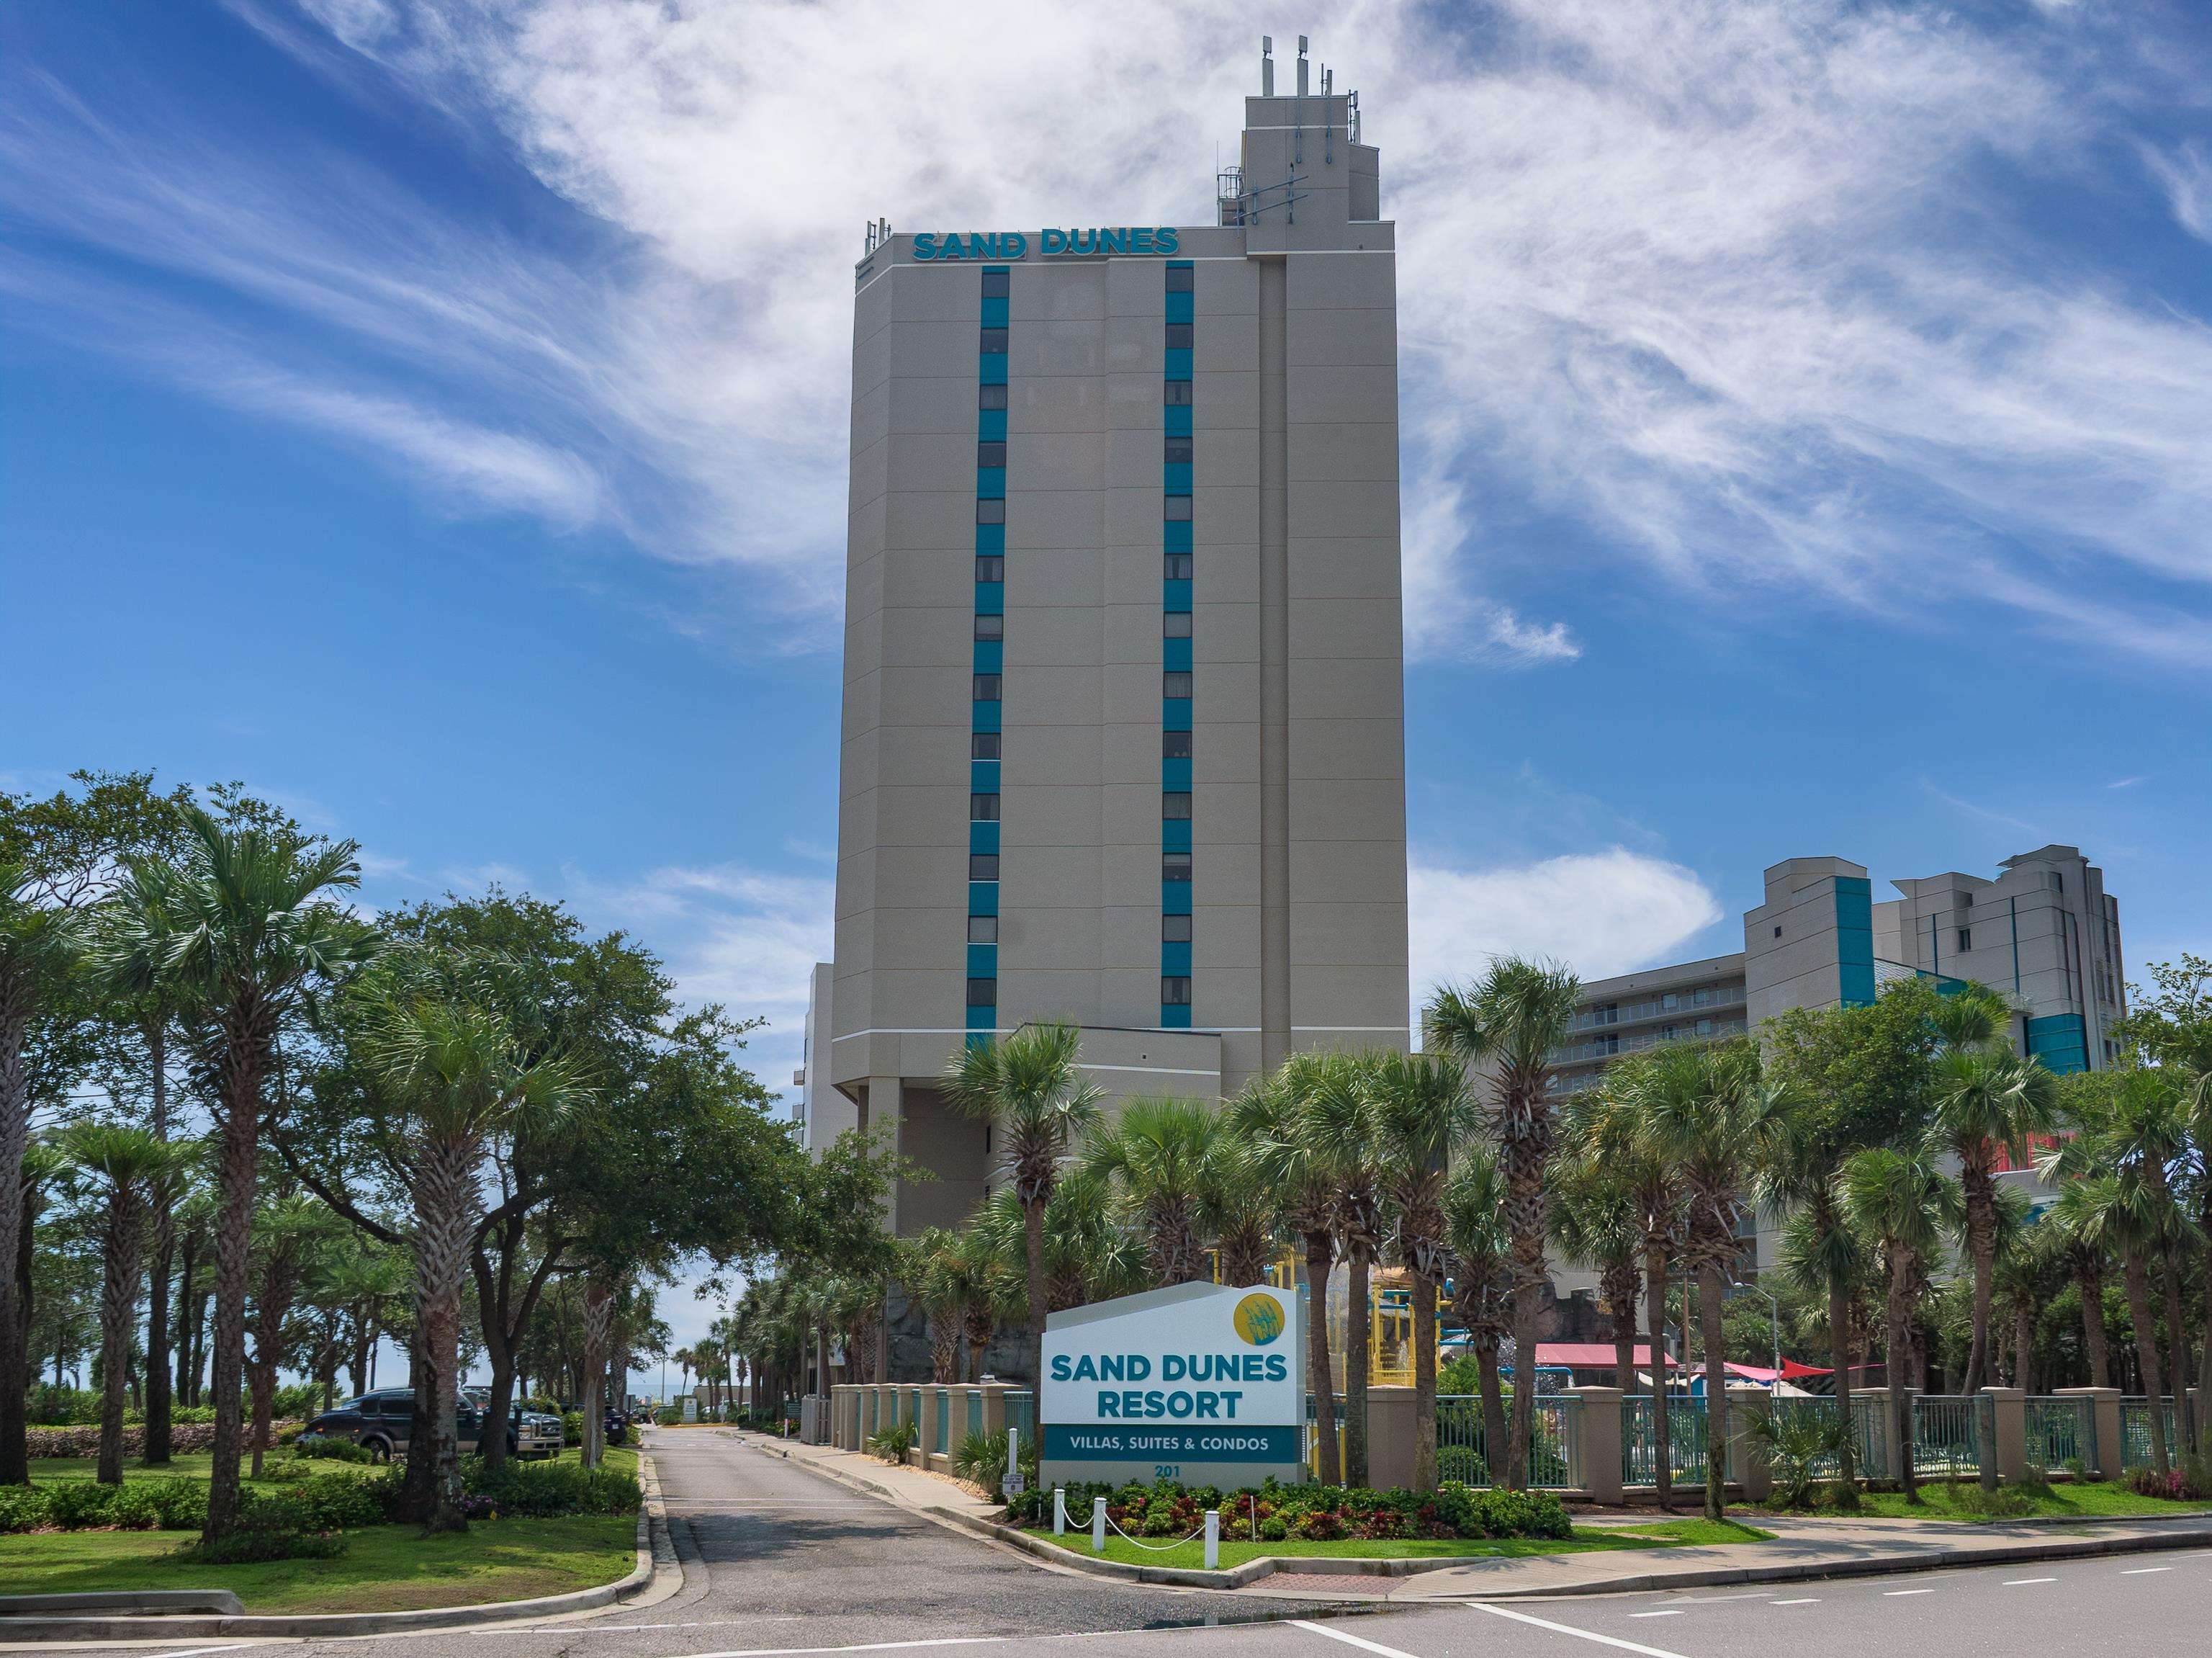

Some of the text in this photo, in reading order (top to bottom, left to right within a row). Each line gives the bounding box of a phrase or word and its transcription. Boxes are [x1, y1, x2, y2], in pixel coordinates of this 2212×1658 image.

[912, 227, 1179, 260] SAND DUNES
[1050, 1354, 1287, 1381] SAND DUNES
[1097, 1391, 1244, 1418] RESORT
[1070, 1436, 1269, 1451] VILLAS, SUITES & CONDOS
[1155, 1465, 1180, 1477] 201
